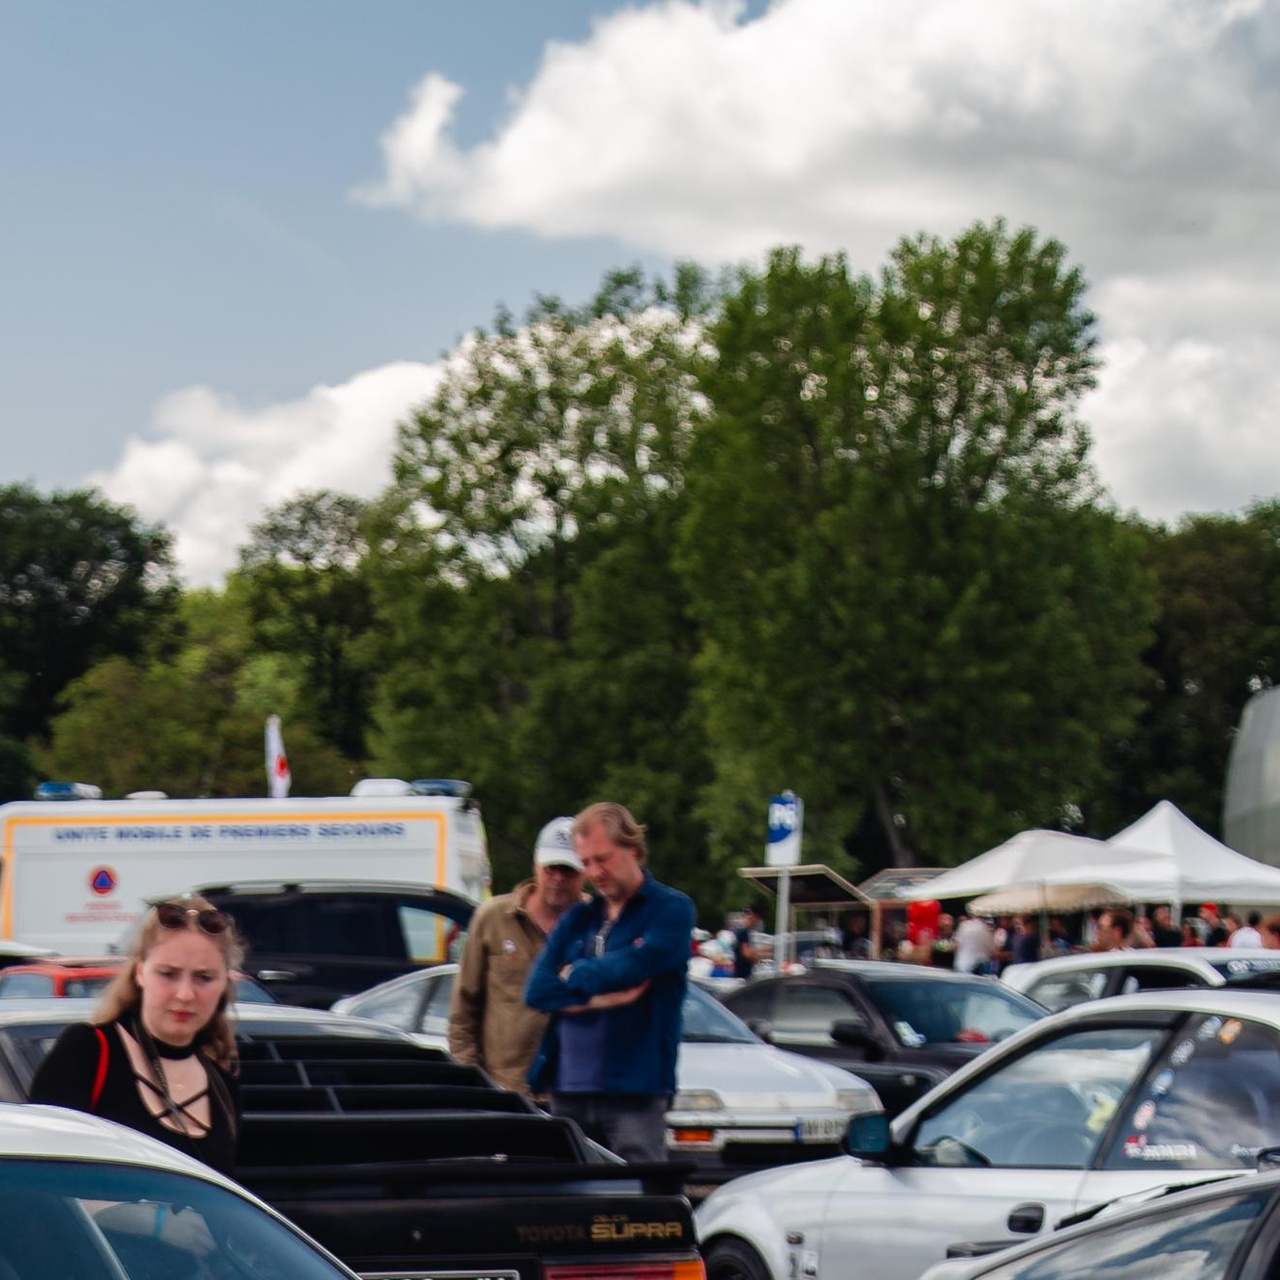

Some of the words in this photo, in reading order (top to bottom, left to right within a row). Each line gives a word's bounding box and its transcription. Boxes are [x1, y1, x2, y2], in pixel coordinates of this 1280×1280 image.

[116, 827, 182, 840] MOBILE
[190, 826, 213, 838] DE
[220, 825, 310, 838] PREMIERS
[318, 823, 405, 836] SECOURS
[518, 1225, 586, 1241] TOYOTA
[591, 1222, 683, 1240] SUPRA
